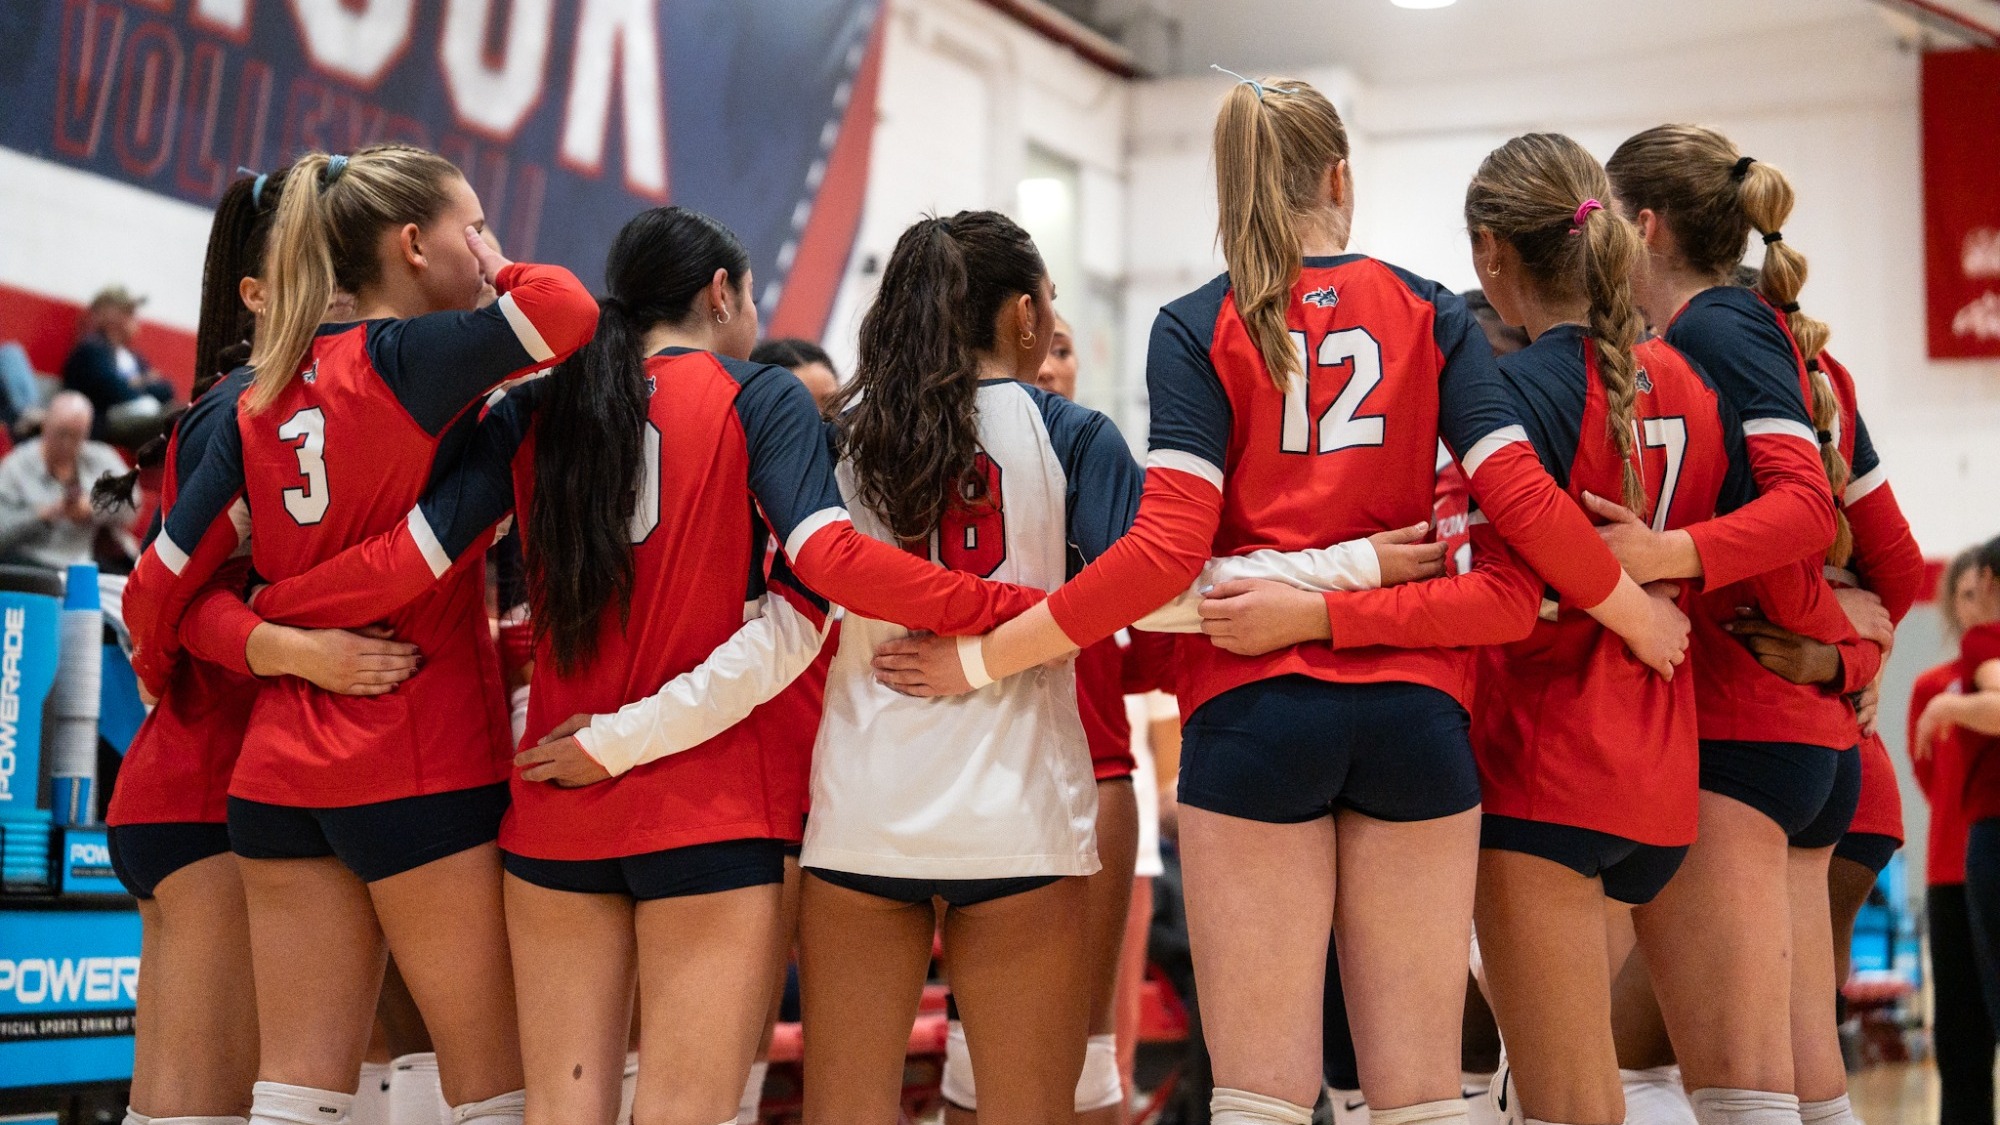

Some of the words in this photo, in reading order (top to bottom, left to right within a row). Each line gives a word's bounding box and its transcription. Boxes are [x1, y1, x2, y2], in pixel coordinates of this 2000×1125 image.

[1280, 325, 1386, 455] 12
[278, 406, 330, 526] 3
[893, 450, 1007, 578] 8
[1631, 415, 1688, 532] 7
